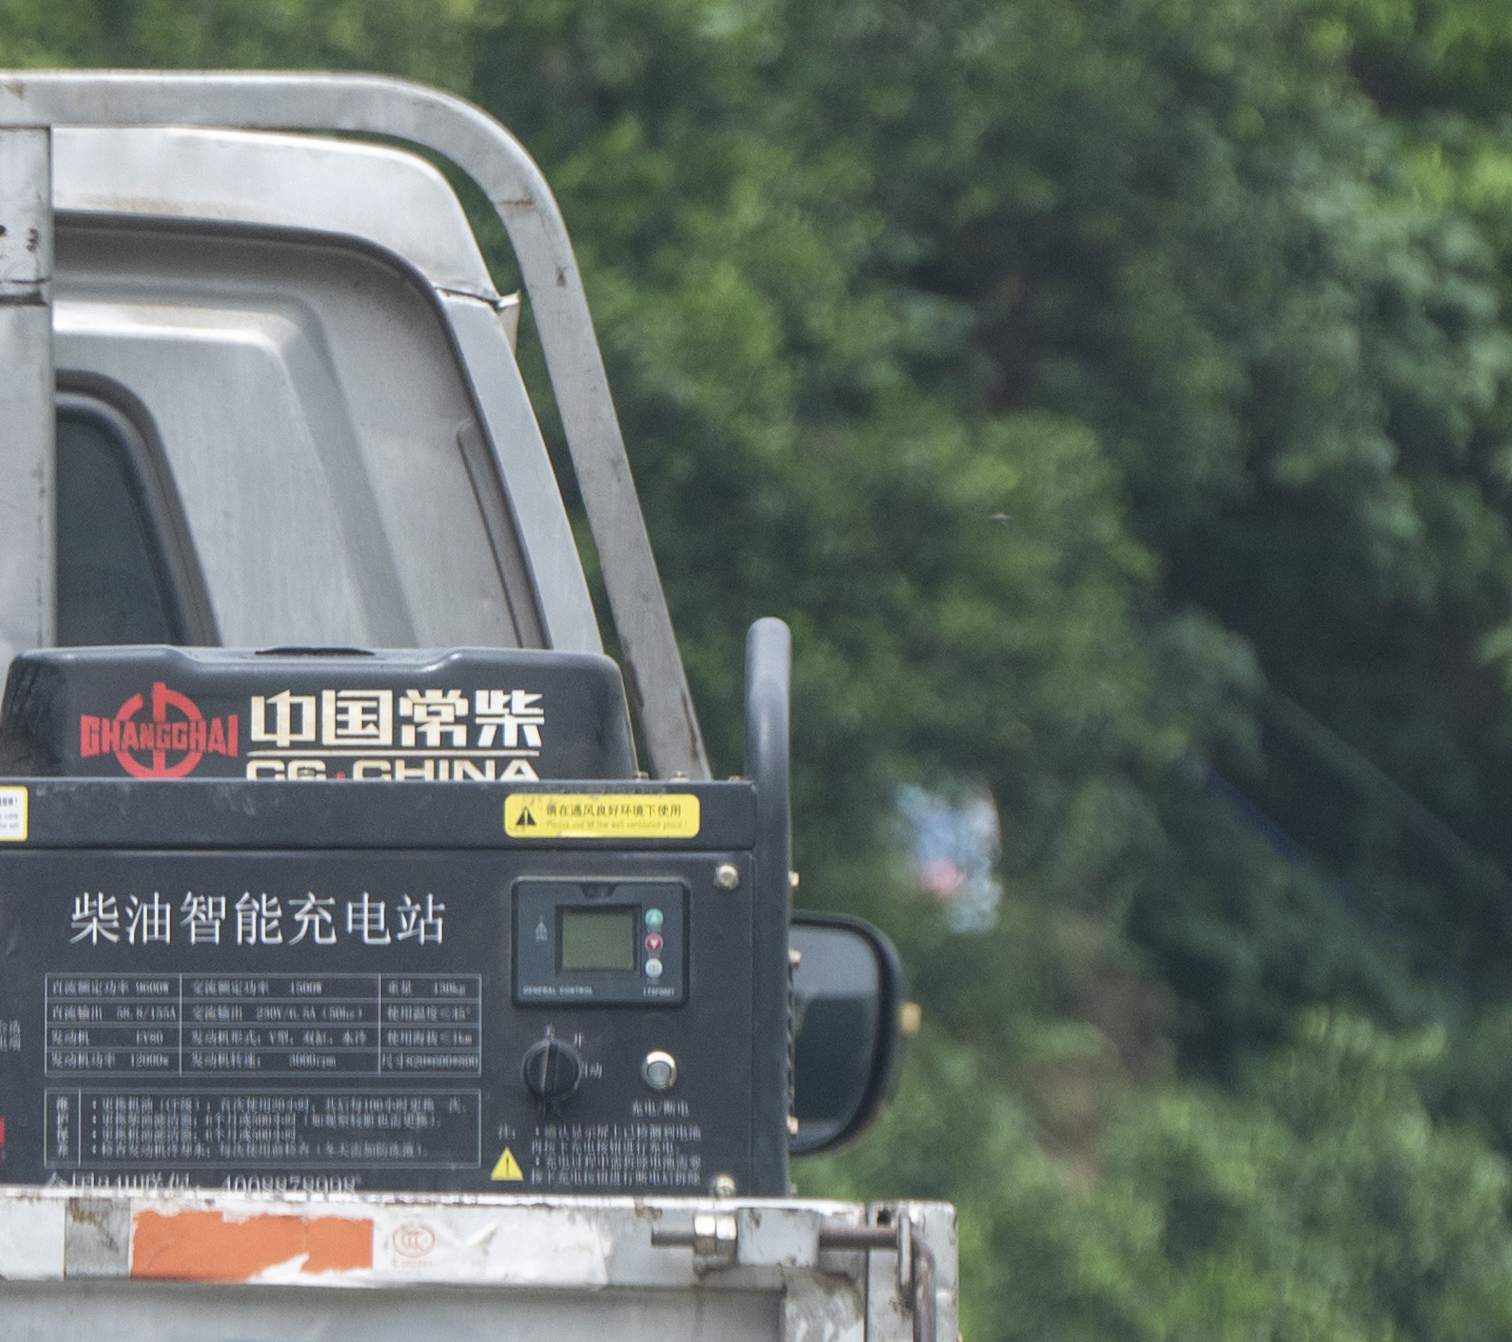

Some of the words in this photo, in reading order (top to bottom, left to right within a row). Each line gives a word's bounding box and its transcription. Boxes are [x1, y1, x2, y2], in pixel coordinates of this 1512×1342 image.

[250, 688, 546, 749] 中国常柴
[69, 891, 446, 946] 柴油智能充电站
